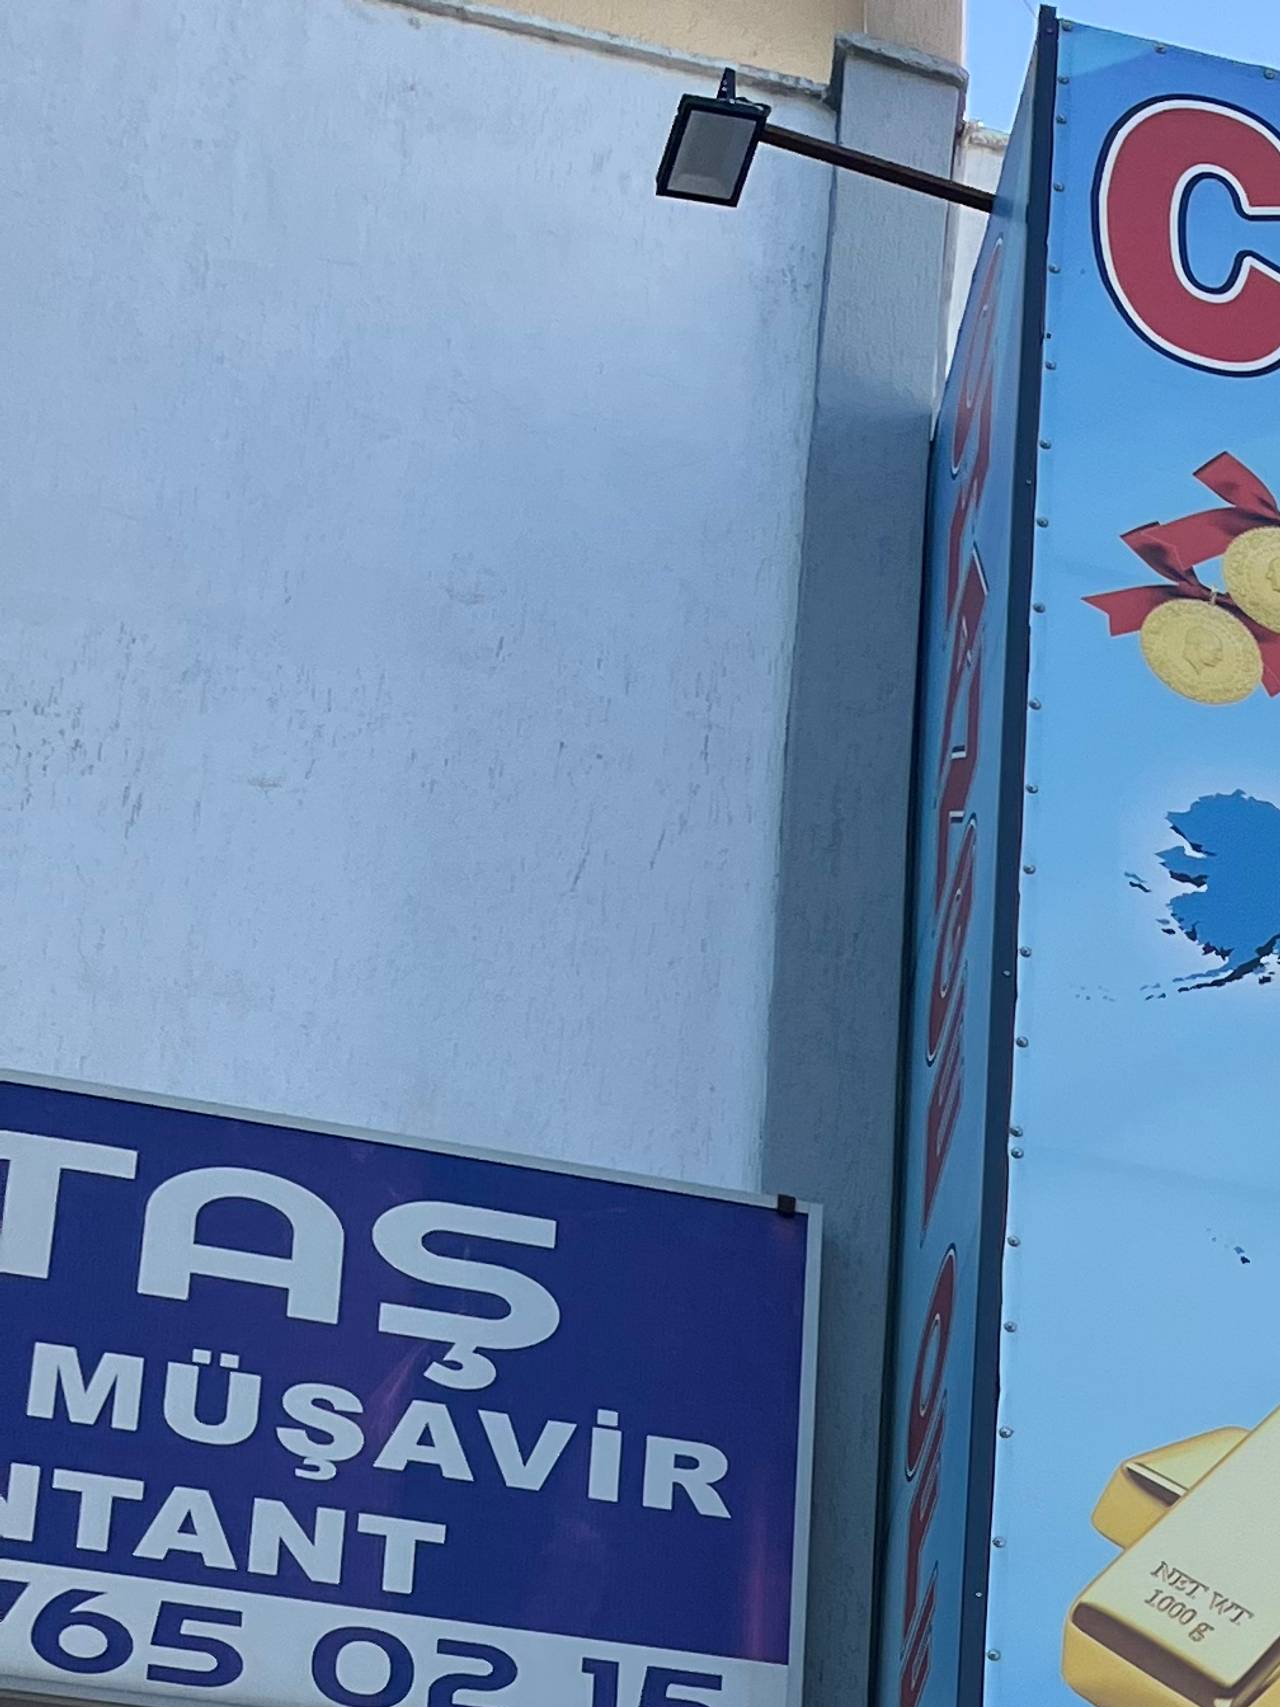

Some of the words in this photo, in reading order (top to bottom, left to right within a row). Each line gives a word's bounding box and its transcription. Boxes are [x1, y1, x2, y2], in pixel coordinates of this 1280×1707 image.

[26, 1341, 732, 1520] MÜŞAVİR
[1144, 1587, 1199, 1627] 1000
[1151, 1560, 1209, 1597] NET
[1205, 1591, 1254, 1627] WT
